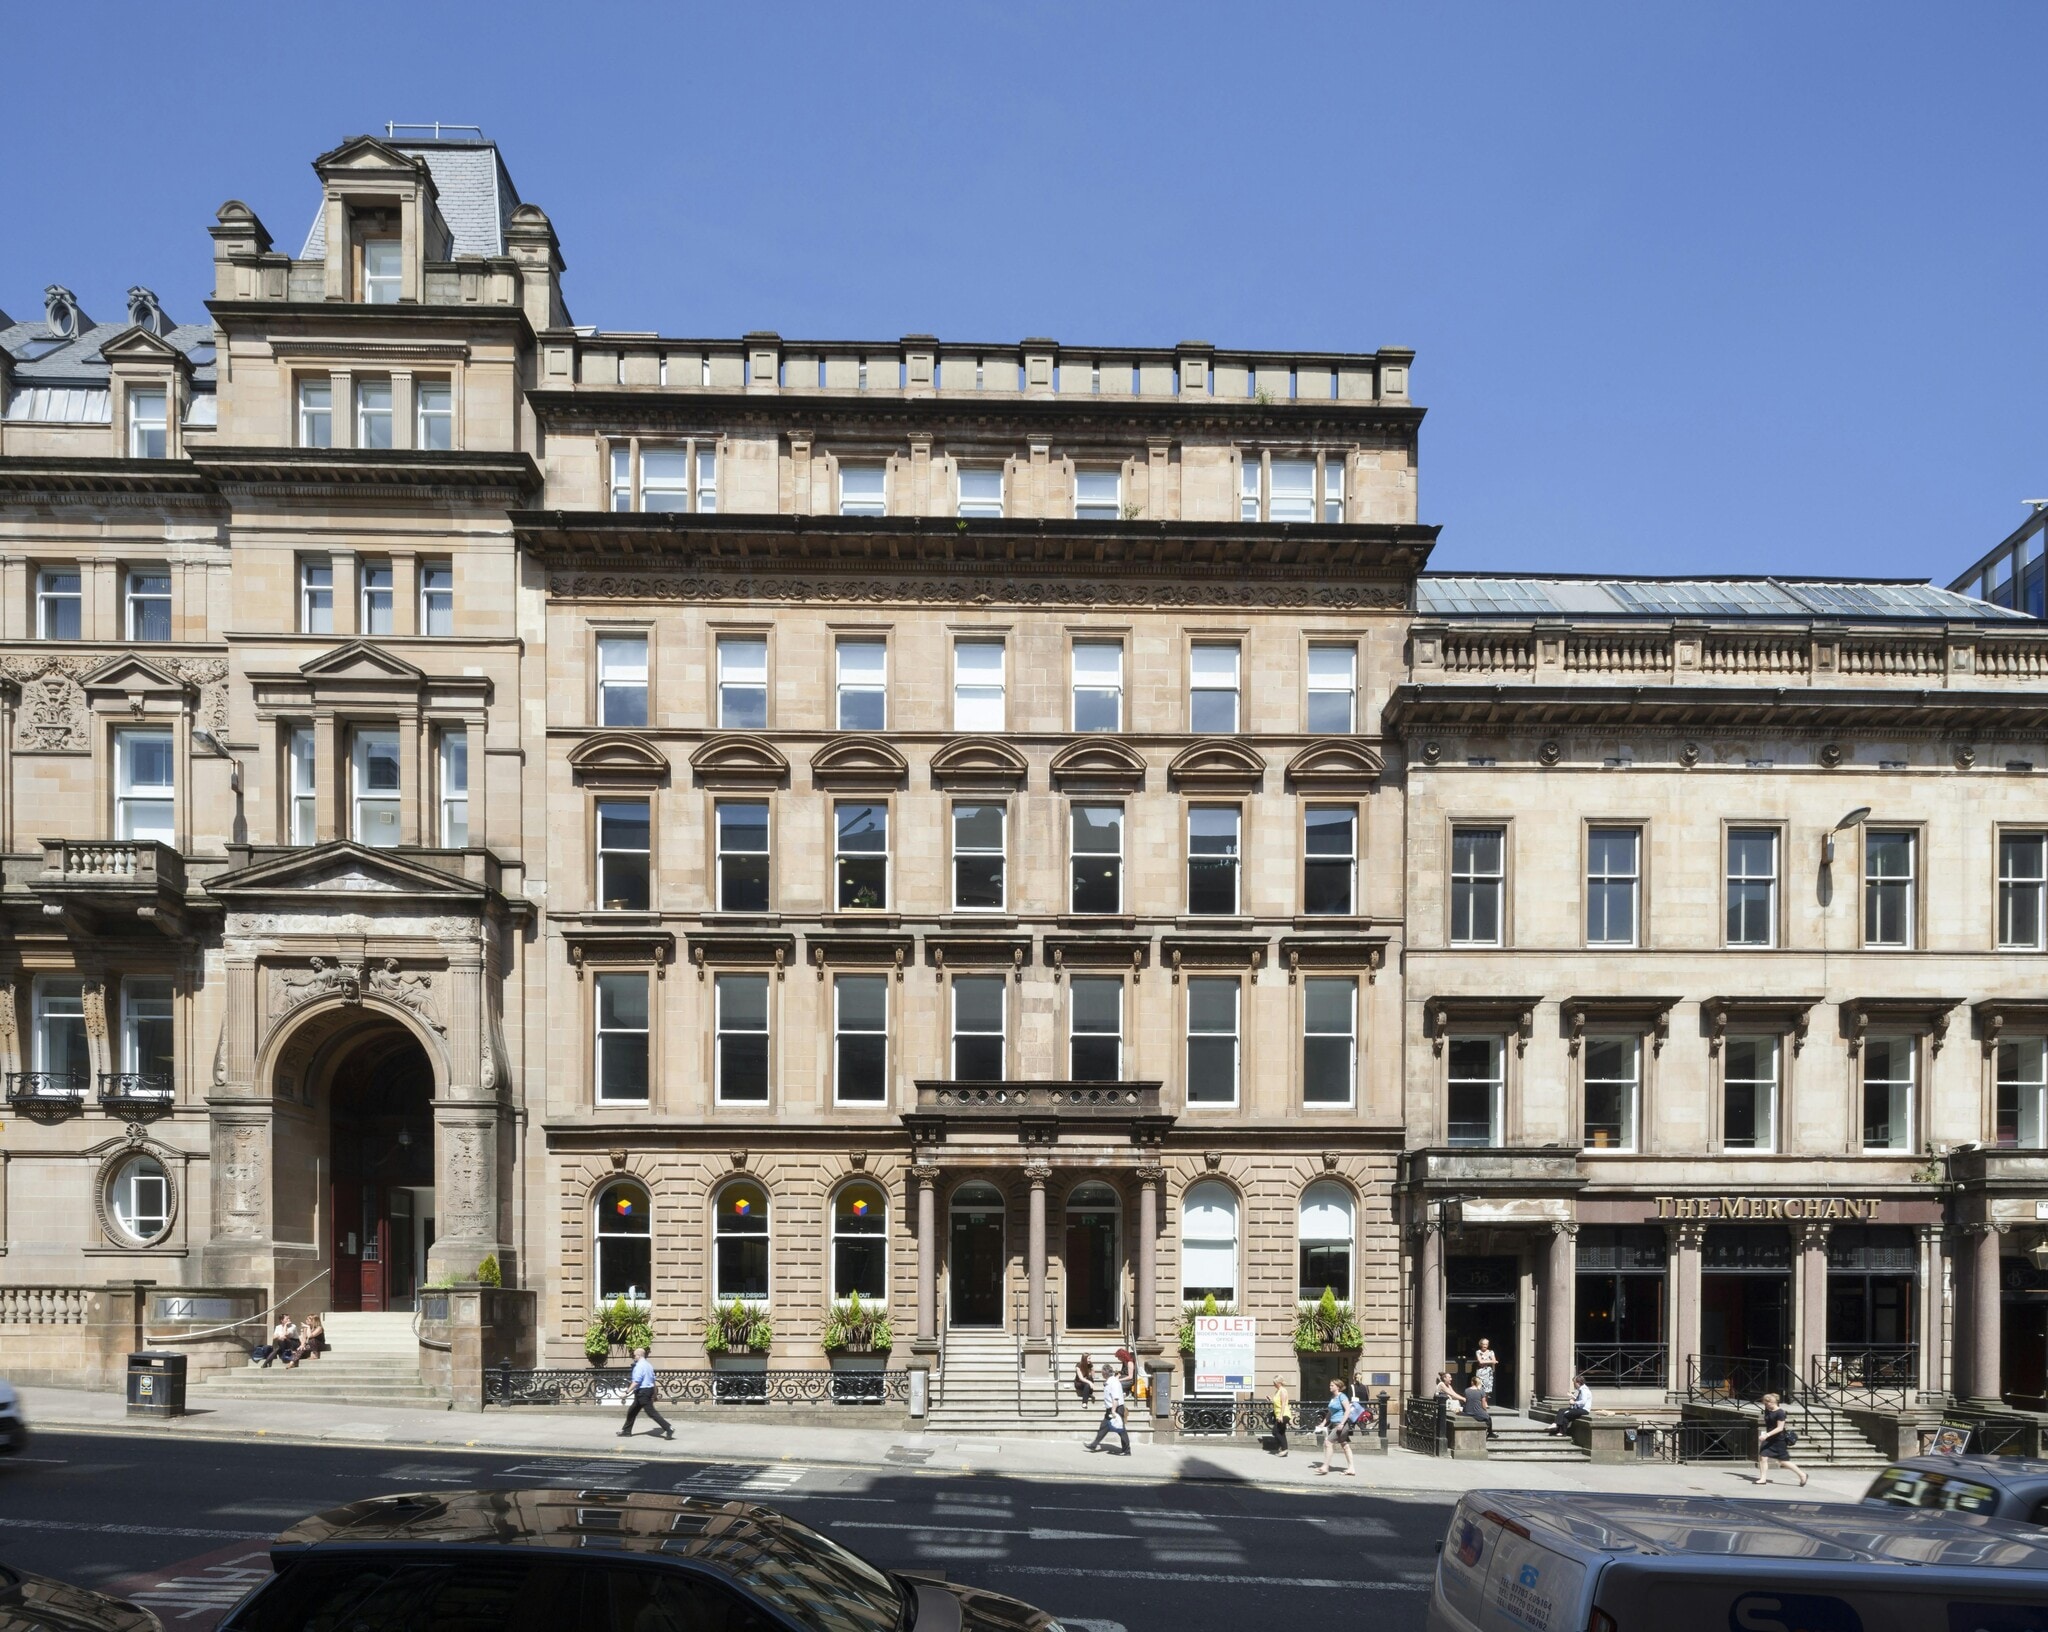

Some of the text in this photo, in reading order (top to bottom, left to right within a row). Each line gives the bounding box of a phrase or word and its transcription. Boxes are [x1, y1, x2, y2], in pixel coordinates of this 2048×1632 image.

[1720, 1196, 1882, 1219] MERCHANT
[160, 1299, 198, 1318] 144
[1196, 1318, 1254, 1331] TO LET
